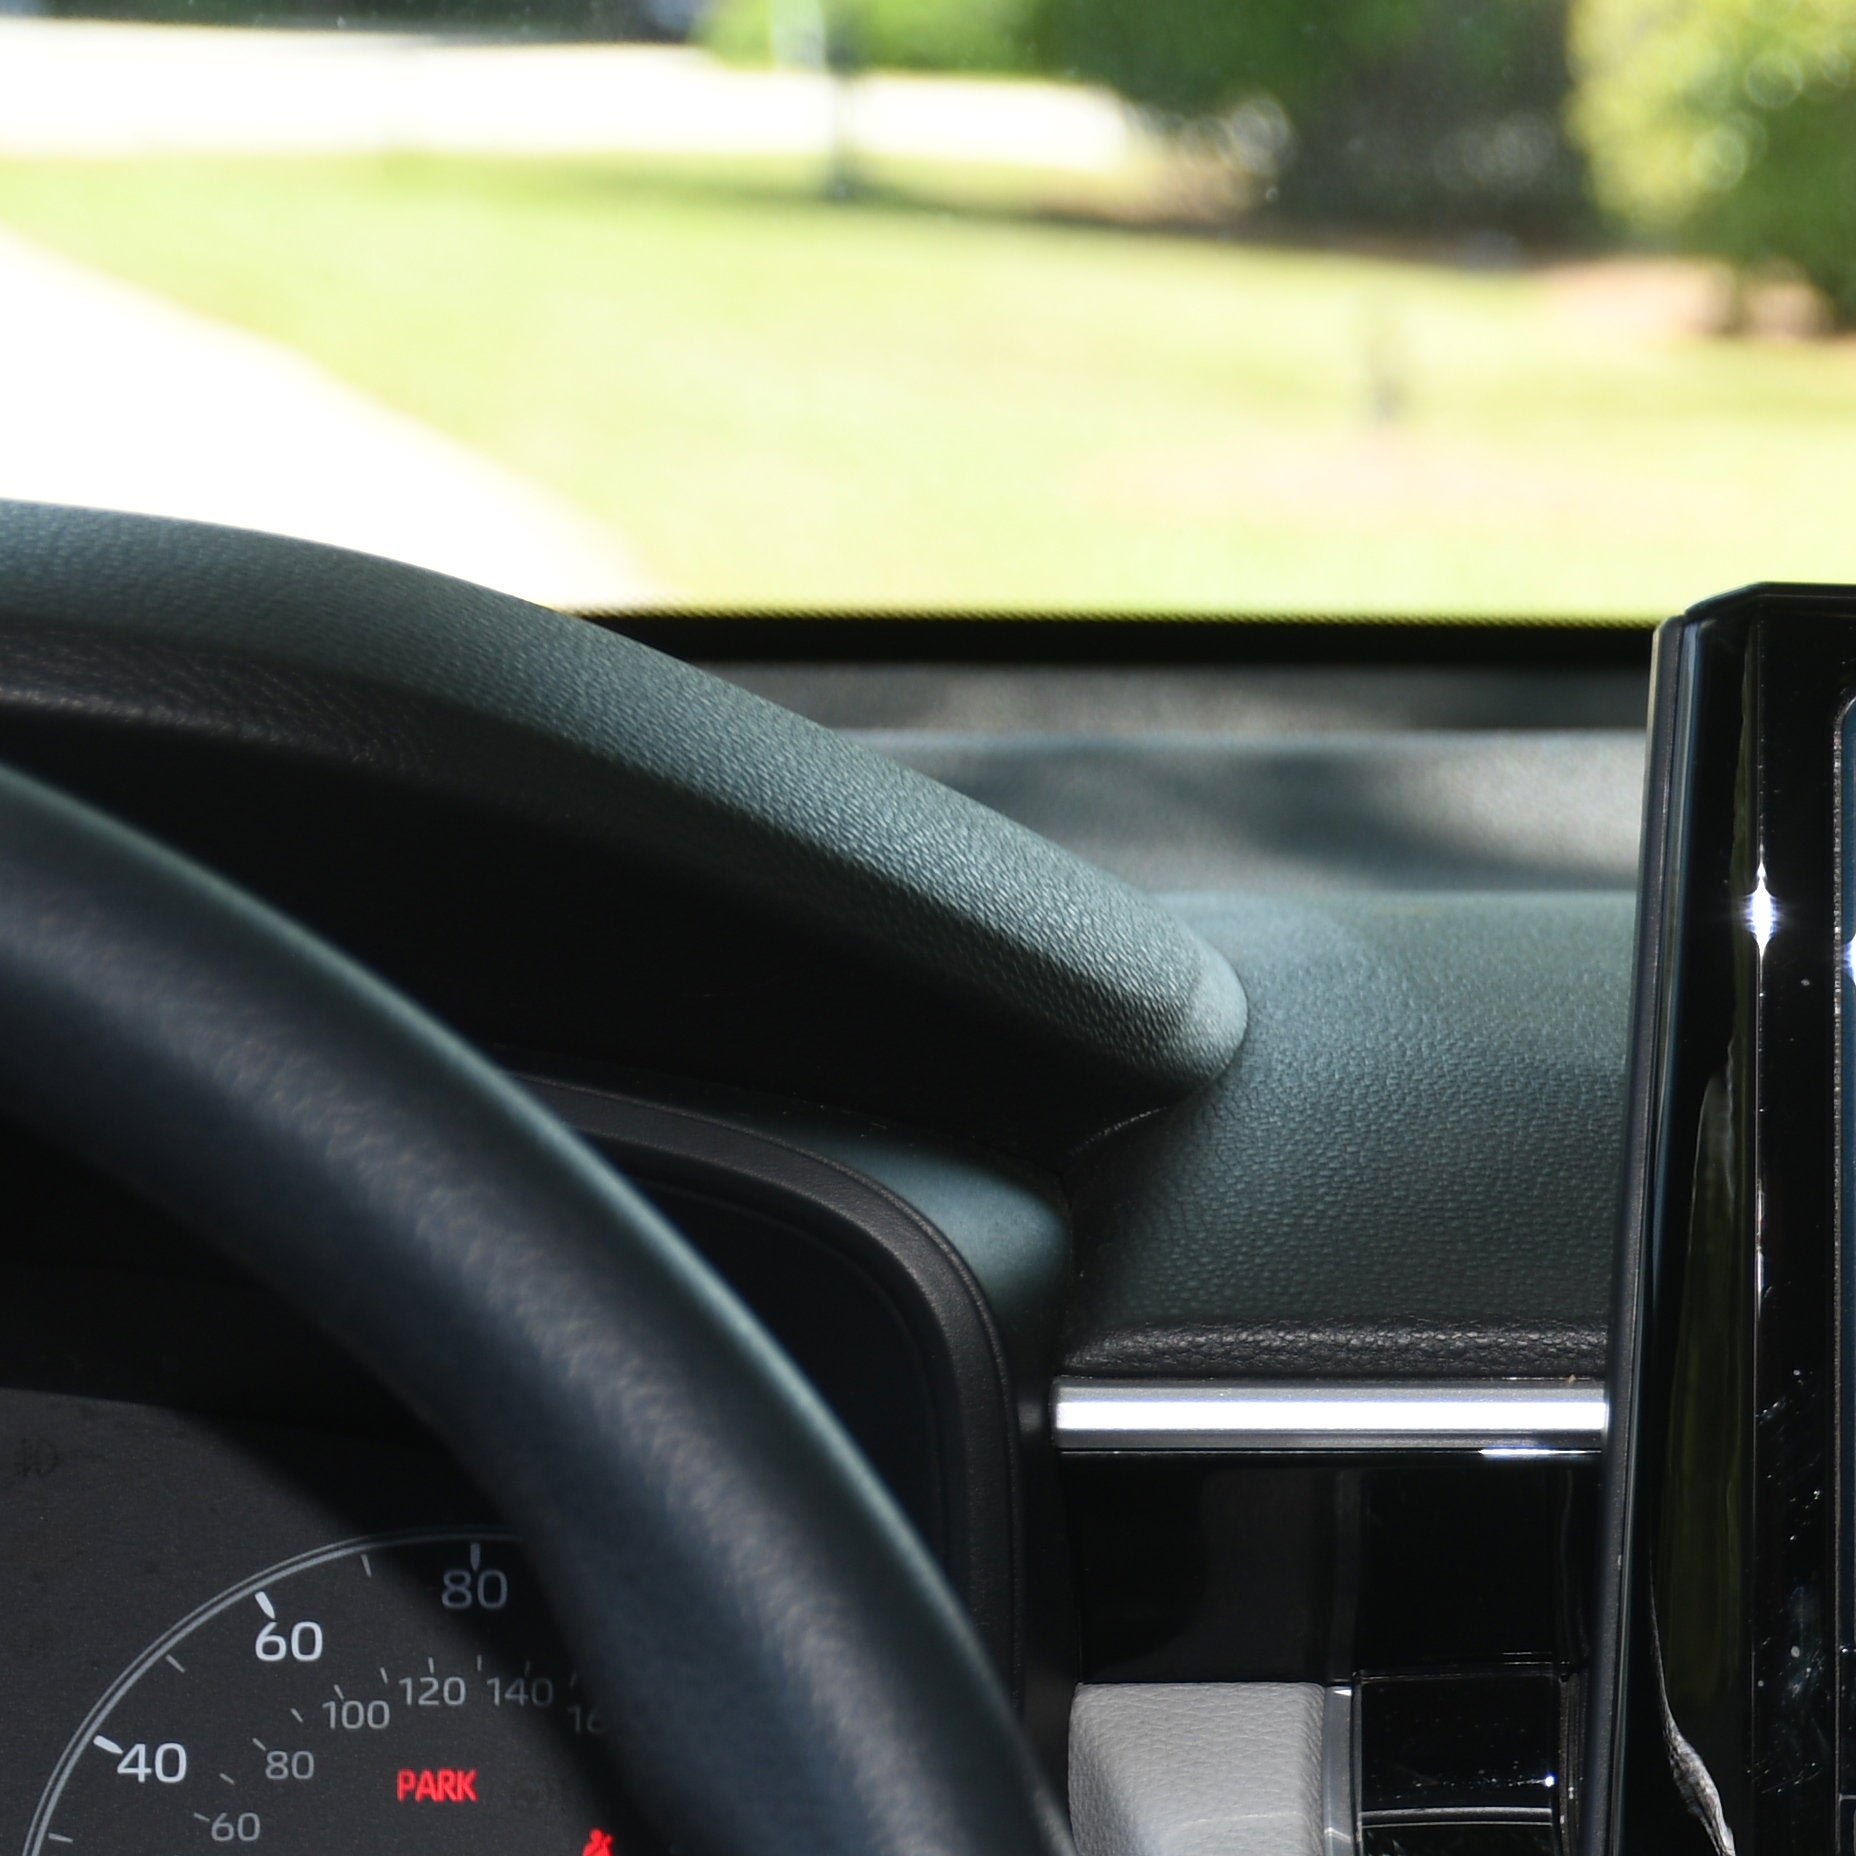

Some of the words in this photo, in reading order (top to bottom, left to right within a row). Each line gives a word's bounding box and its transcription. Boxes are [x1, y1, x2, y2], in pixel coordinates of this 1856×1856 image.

[440, 1569, 508, 1610] 80
[254, 1620, 324, 1662] 60
[398, 1676, 467, 1707] 120
[485, 1676, 553, 1706] 140
[322, 1700, 390, 1730] 100
[116, 1742, 188, 1784] 40
[265, 1750, 315, 1780] 80
[397, 1769, 477, 1802] PARK
[210, 1812, 261, 1842] 60
